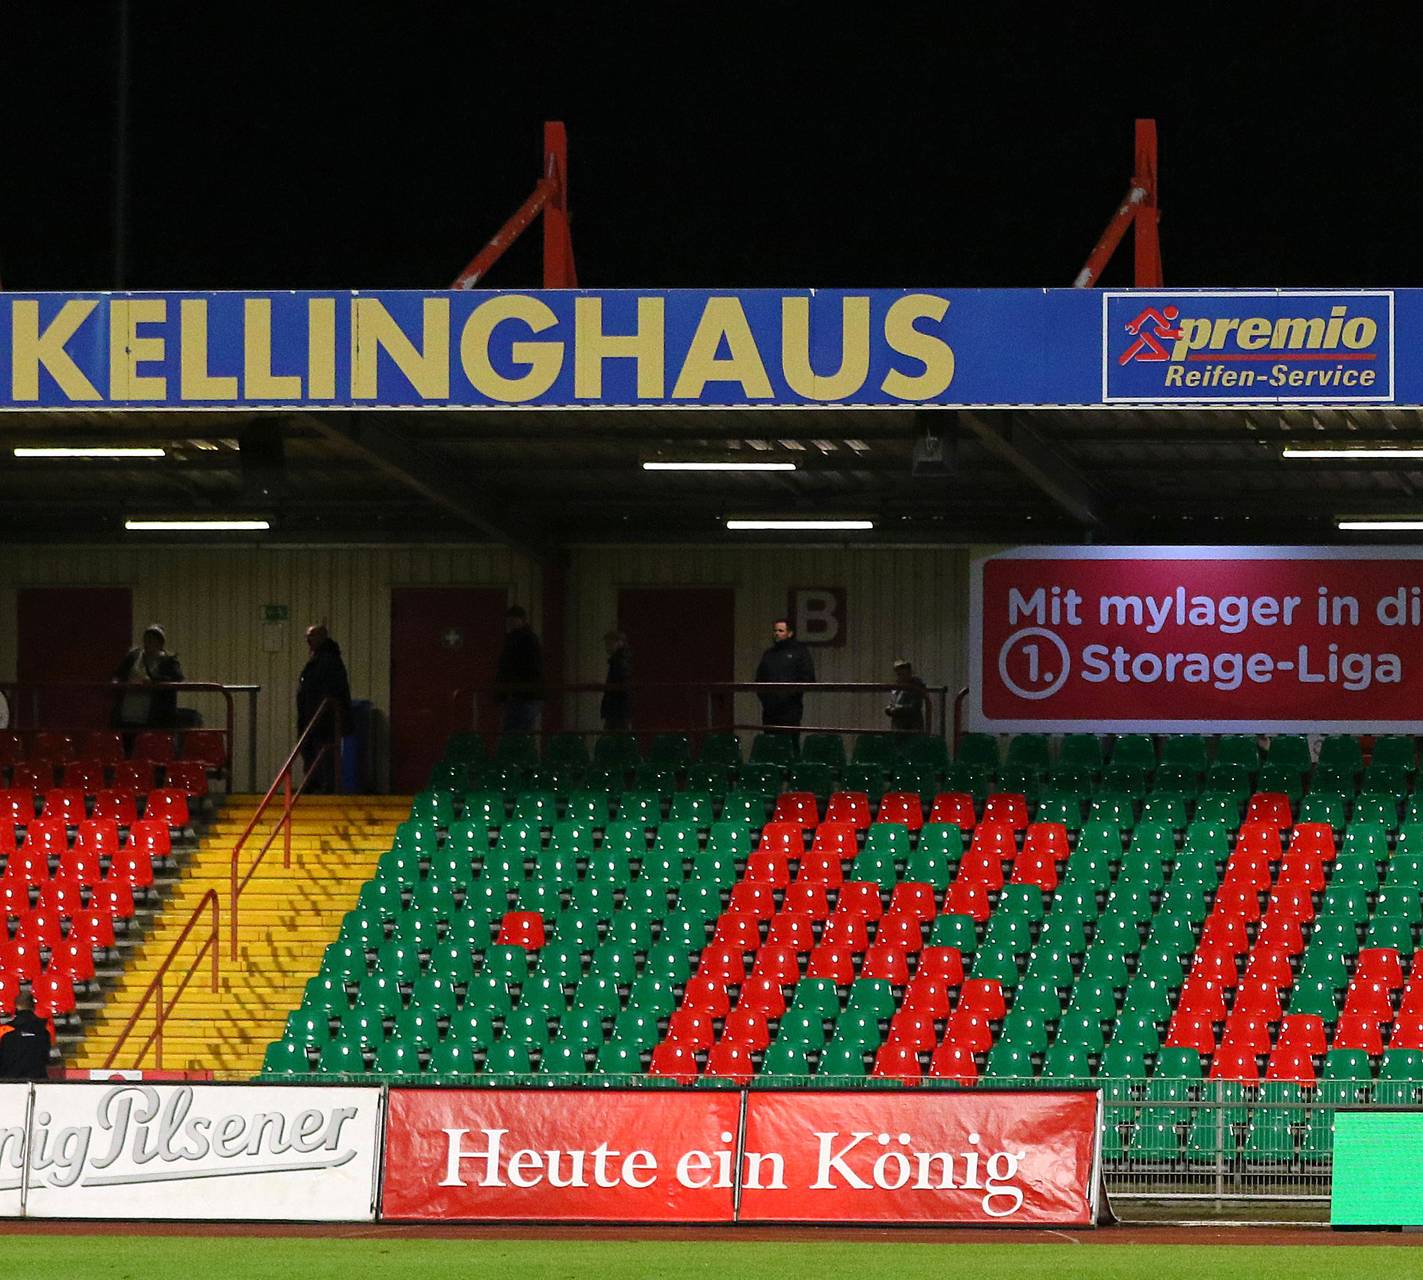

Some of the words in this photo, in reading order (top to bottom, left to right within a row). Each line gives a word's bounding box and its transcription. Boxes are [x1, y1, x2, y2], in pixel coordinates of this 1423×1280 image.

[11, 293, 956, 402] KELLINGHAUS
[1171, 305, 1377, 362] premio
[1164, 364, 1376, 387] Reifen-Service
[796, 590, 839, 642] B
[1008, 586, 1083, 626] Mit
[1099, 586, 1302, 634] mylager
[1317, 586, 1360, 626] in
[1080, 643, 1402, 691] Storage-Liga
[90, 1086, 358, 1169] Pilsener
[438, 1128, 658, 1188] Heute
[676, 1132, 788, 1190] ein
[812, 1132, 1026, 1216] König
